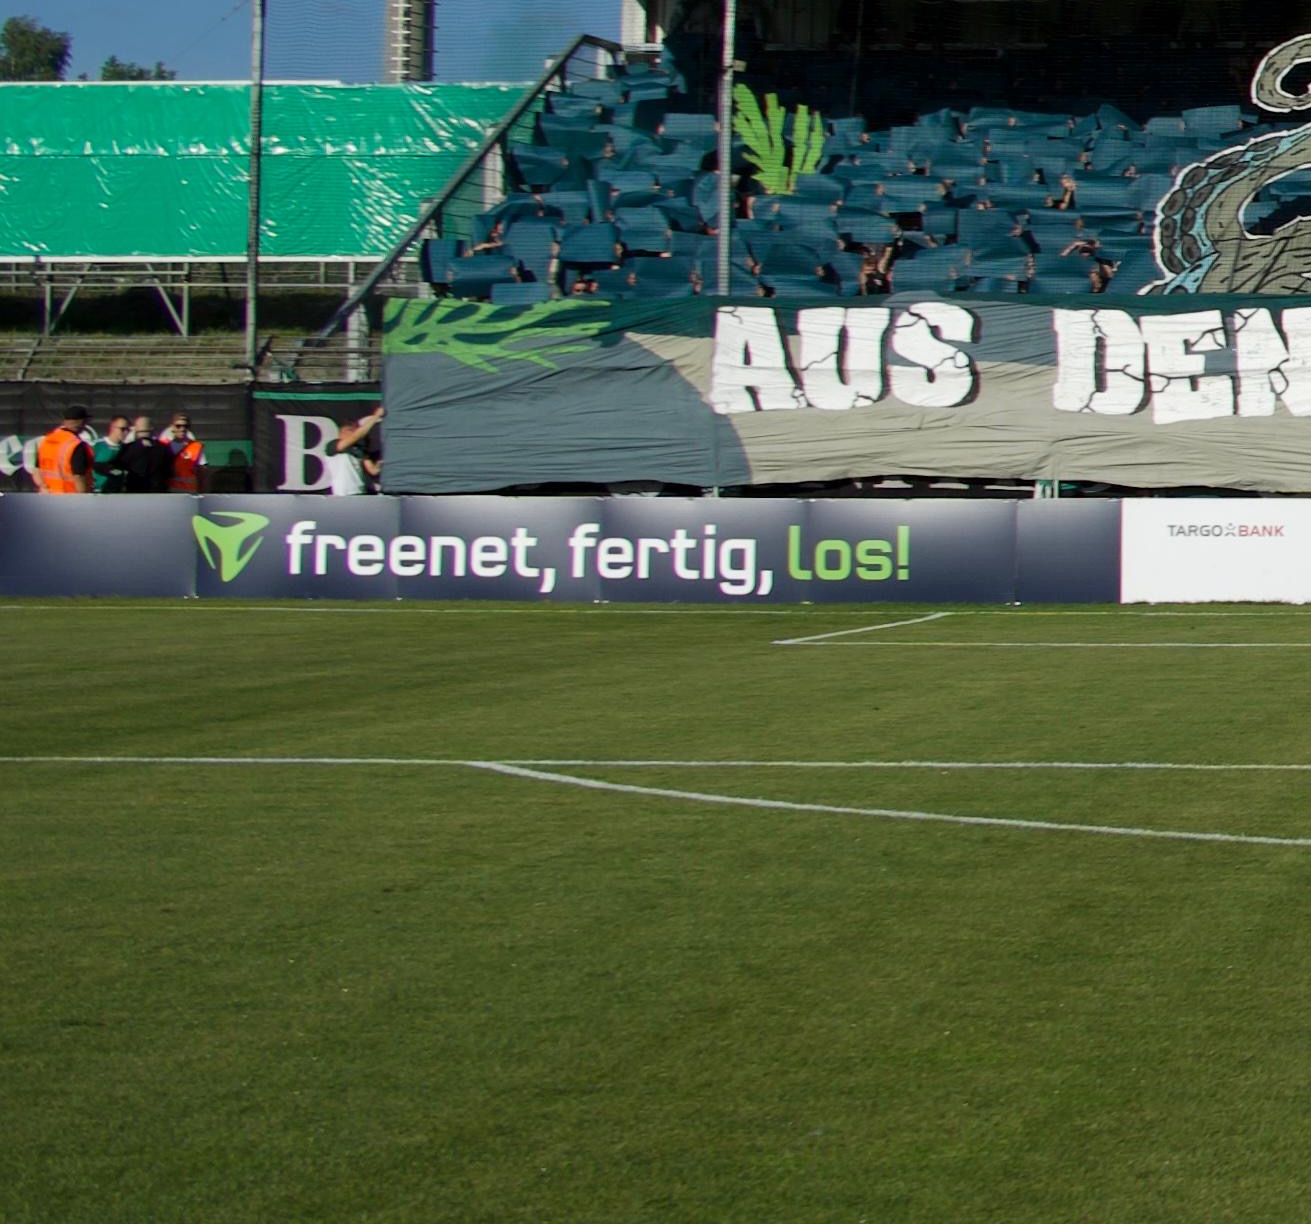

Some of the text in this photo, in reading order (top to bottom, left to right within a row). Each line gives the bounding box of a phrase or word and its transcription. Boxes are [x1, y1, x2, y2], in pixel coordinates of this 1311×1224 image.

[708, 301, 981, 415] AUS
[286, 520, 910, 596] freenet, fertig, los!
